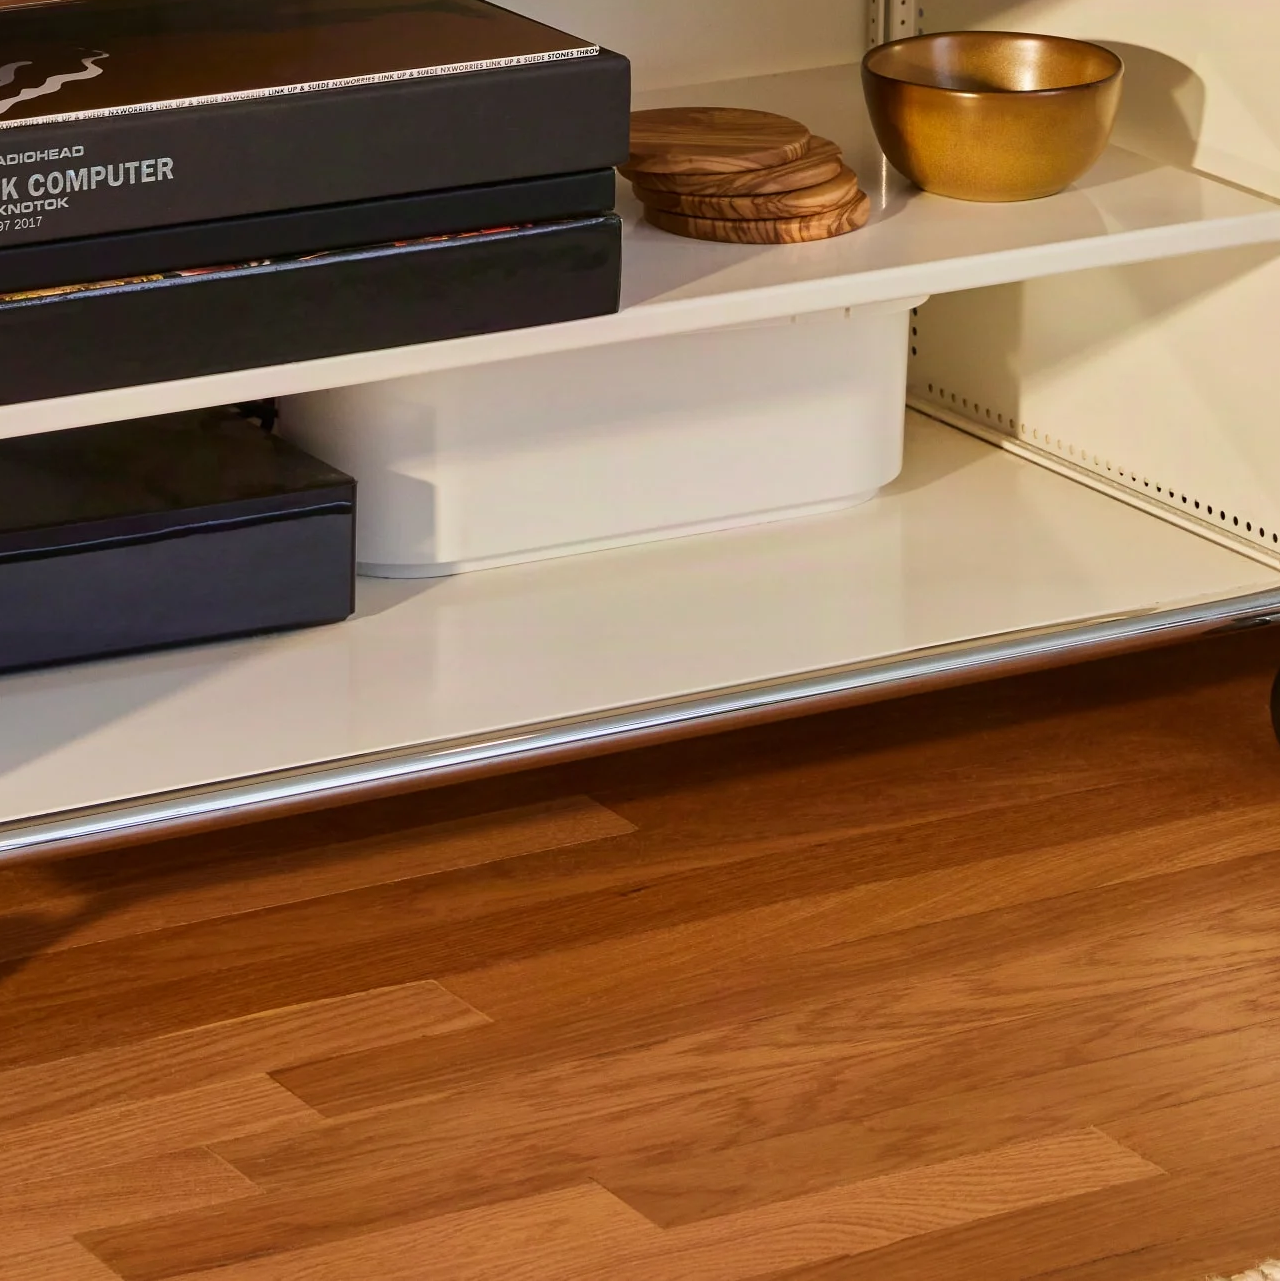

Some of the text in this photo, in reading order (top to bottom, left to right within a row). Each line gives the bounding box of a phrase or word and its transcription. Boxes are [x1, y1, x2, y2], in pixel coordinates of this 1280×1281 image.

[81, 110, 106, 119] SUEDE
[107, 103, 154, 116] NXWORRIES
[155, 101, 173, 110] LINK
[174, 99, 185, 107] UP
[195, 95, 219, 105] SUEDE
[220, 89, 266, 102] NXWORRIES
[267, 87, 285, 96] LINK
[286, 85, 297, 93] UP
[306, 81, 330, 91] SUEDE
[330, 75, 376, 87] NXWORRIES
[377, 73, 394, 81] LINK
[396, 71, 407, 79] UP
[415, 67, 438, 76] SUEDE
[439, 61, 484, 73] NXWORRIES
[484, 59, 502, 68] LINK
[503, 57, 513, 65] UP
[523, 53, 546, 63] SUEDE
[546, 50, 574, 60] STONES
[27, 157, 174, 197] COMPUTER
[14, 217, 43, 230] 2017
